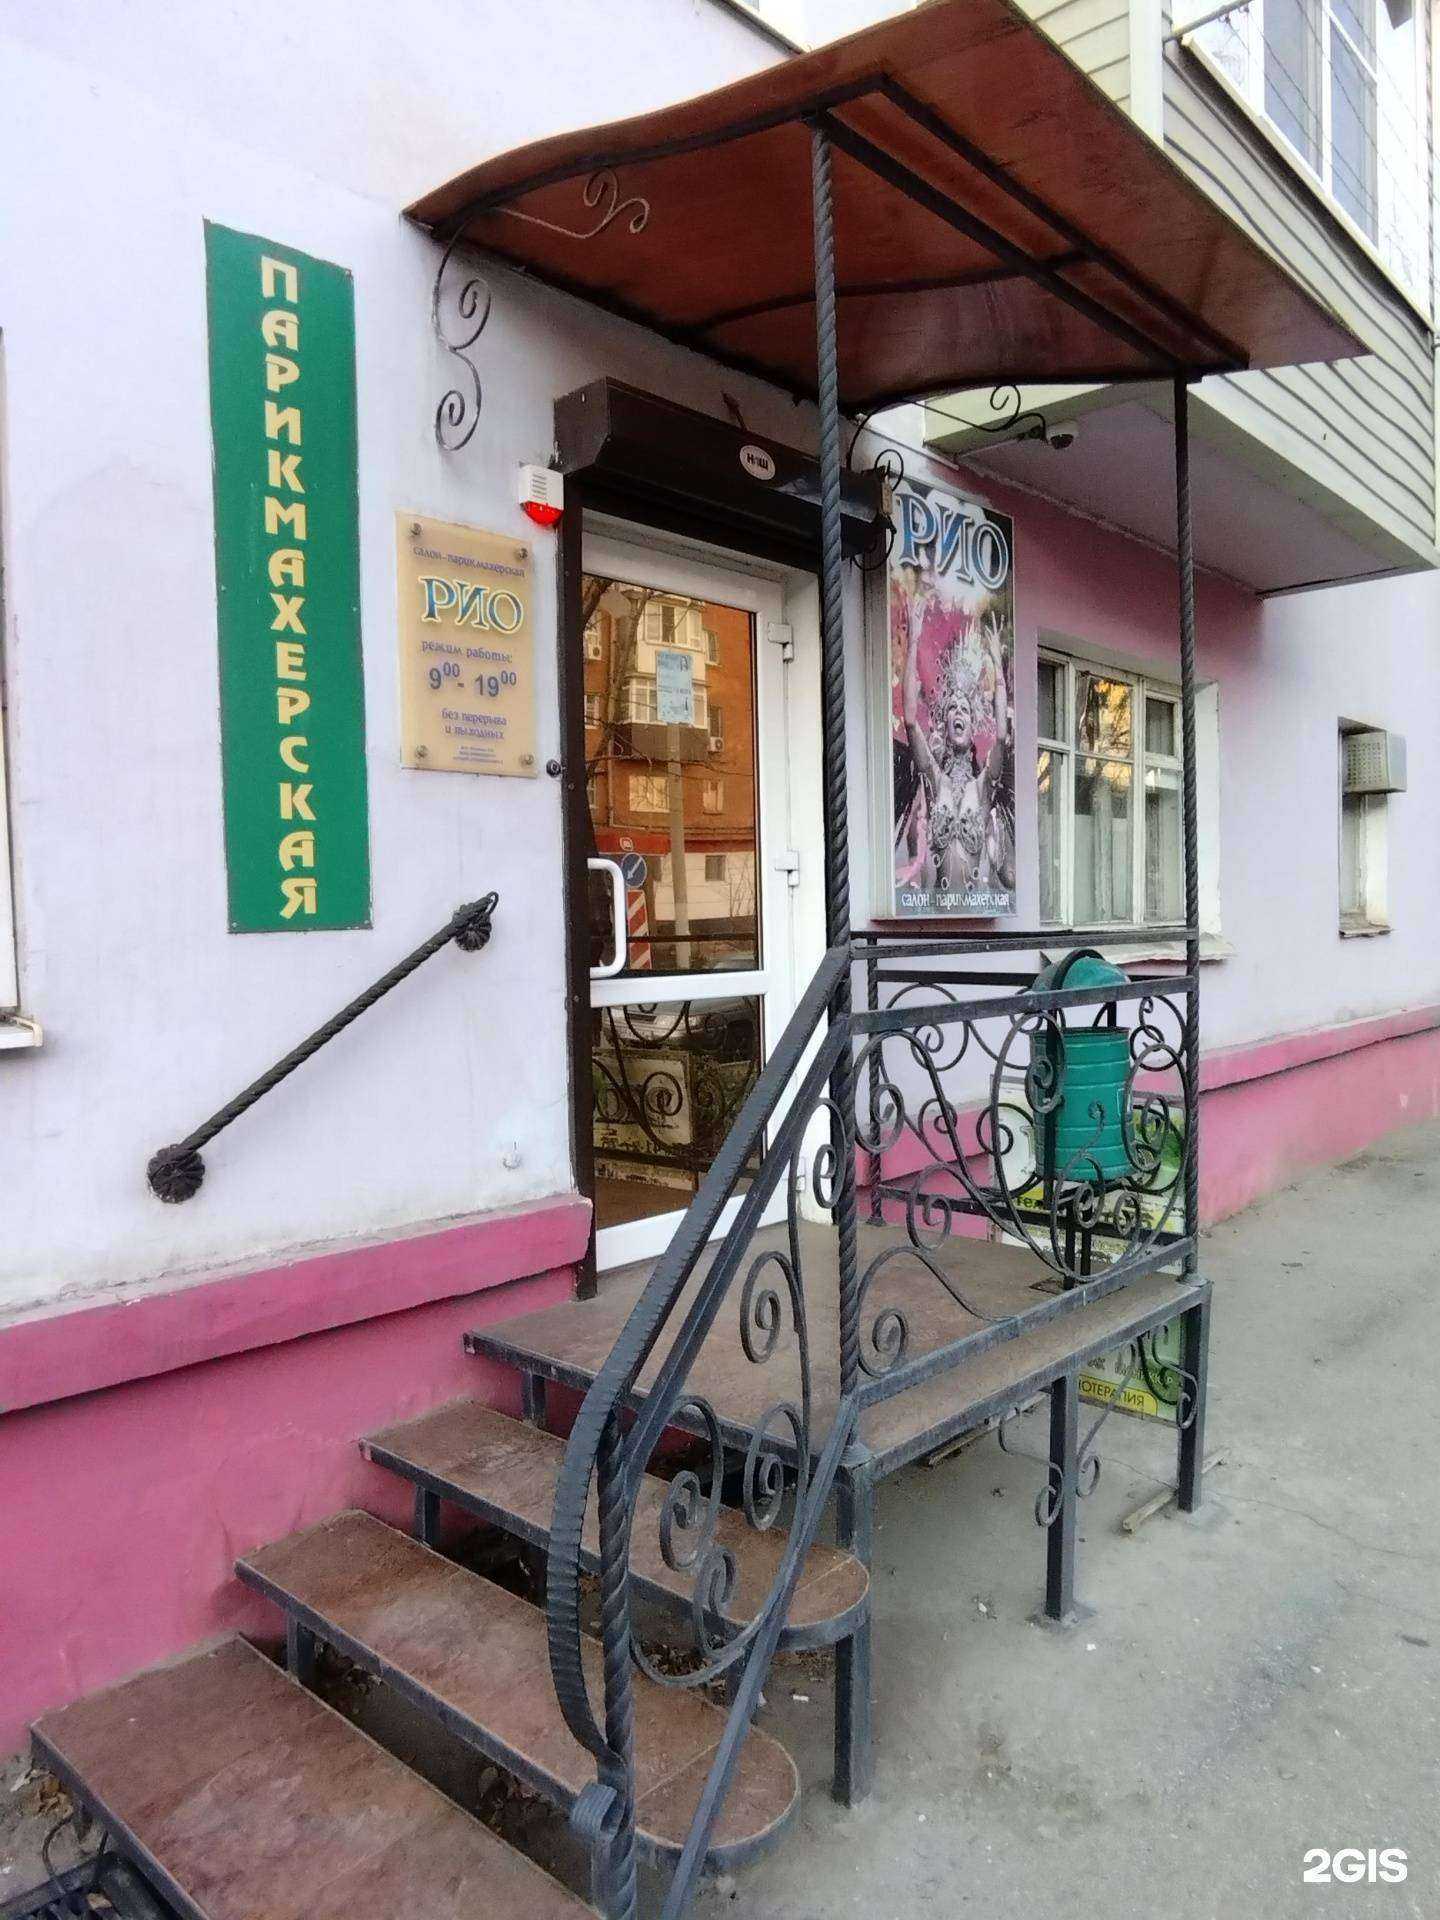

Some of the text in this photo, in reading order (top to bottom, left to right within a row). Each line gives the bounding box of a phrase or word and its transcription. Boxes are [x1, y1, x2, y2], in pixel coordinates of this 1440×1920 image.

[897, 492, 1010, 590] РИО
[261, 255, 318, 919] ПАРИКМАХЕРСКАЯ
[418, 575, 525, 634] РИО
[422, 641, 462, 656] режим
[442, 708, 459, 721] без
